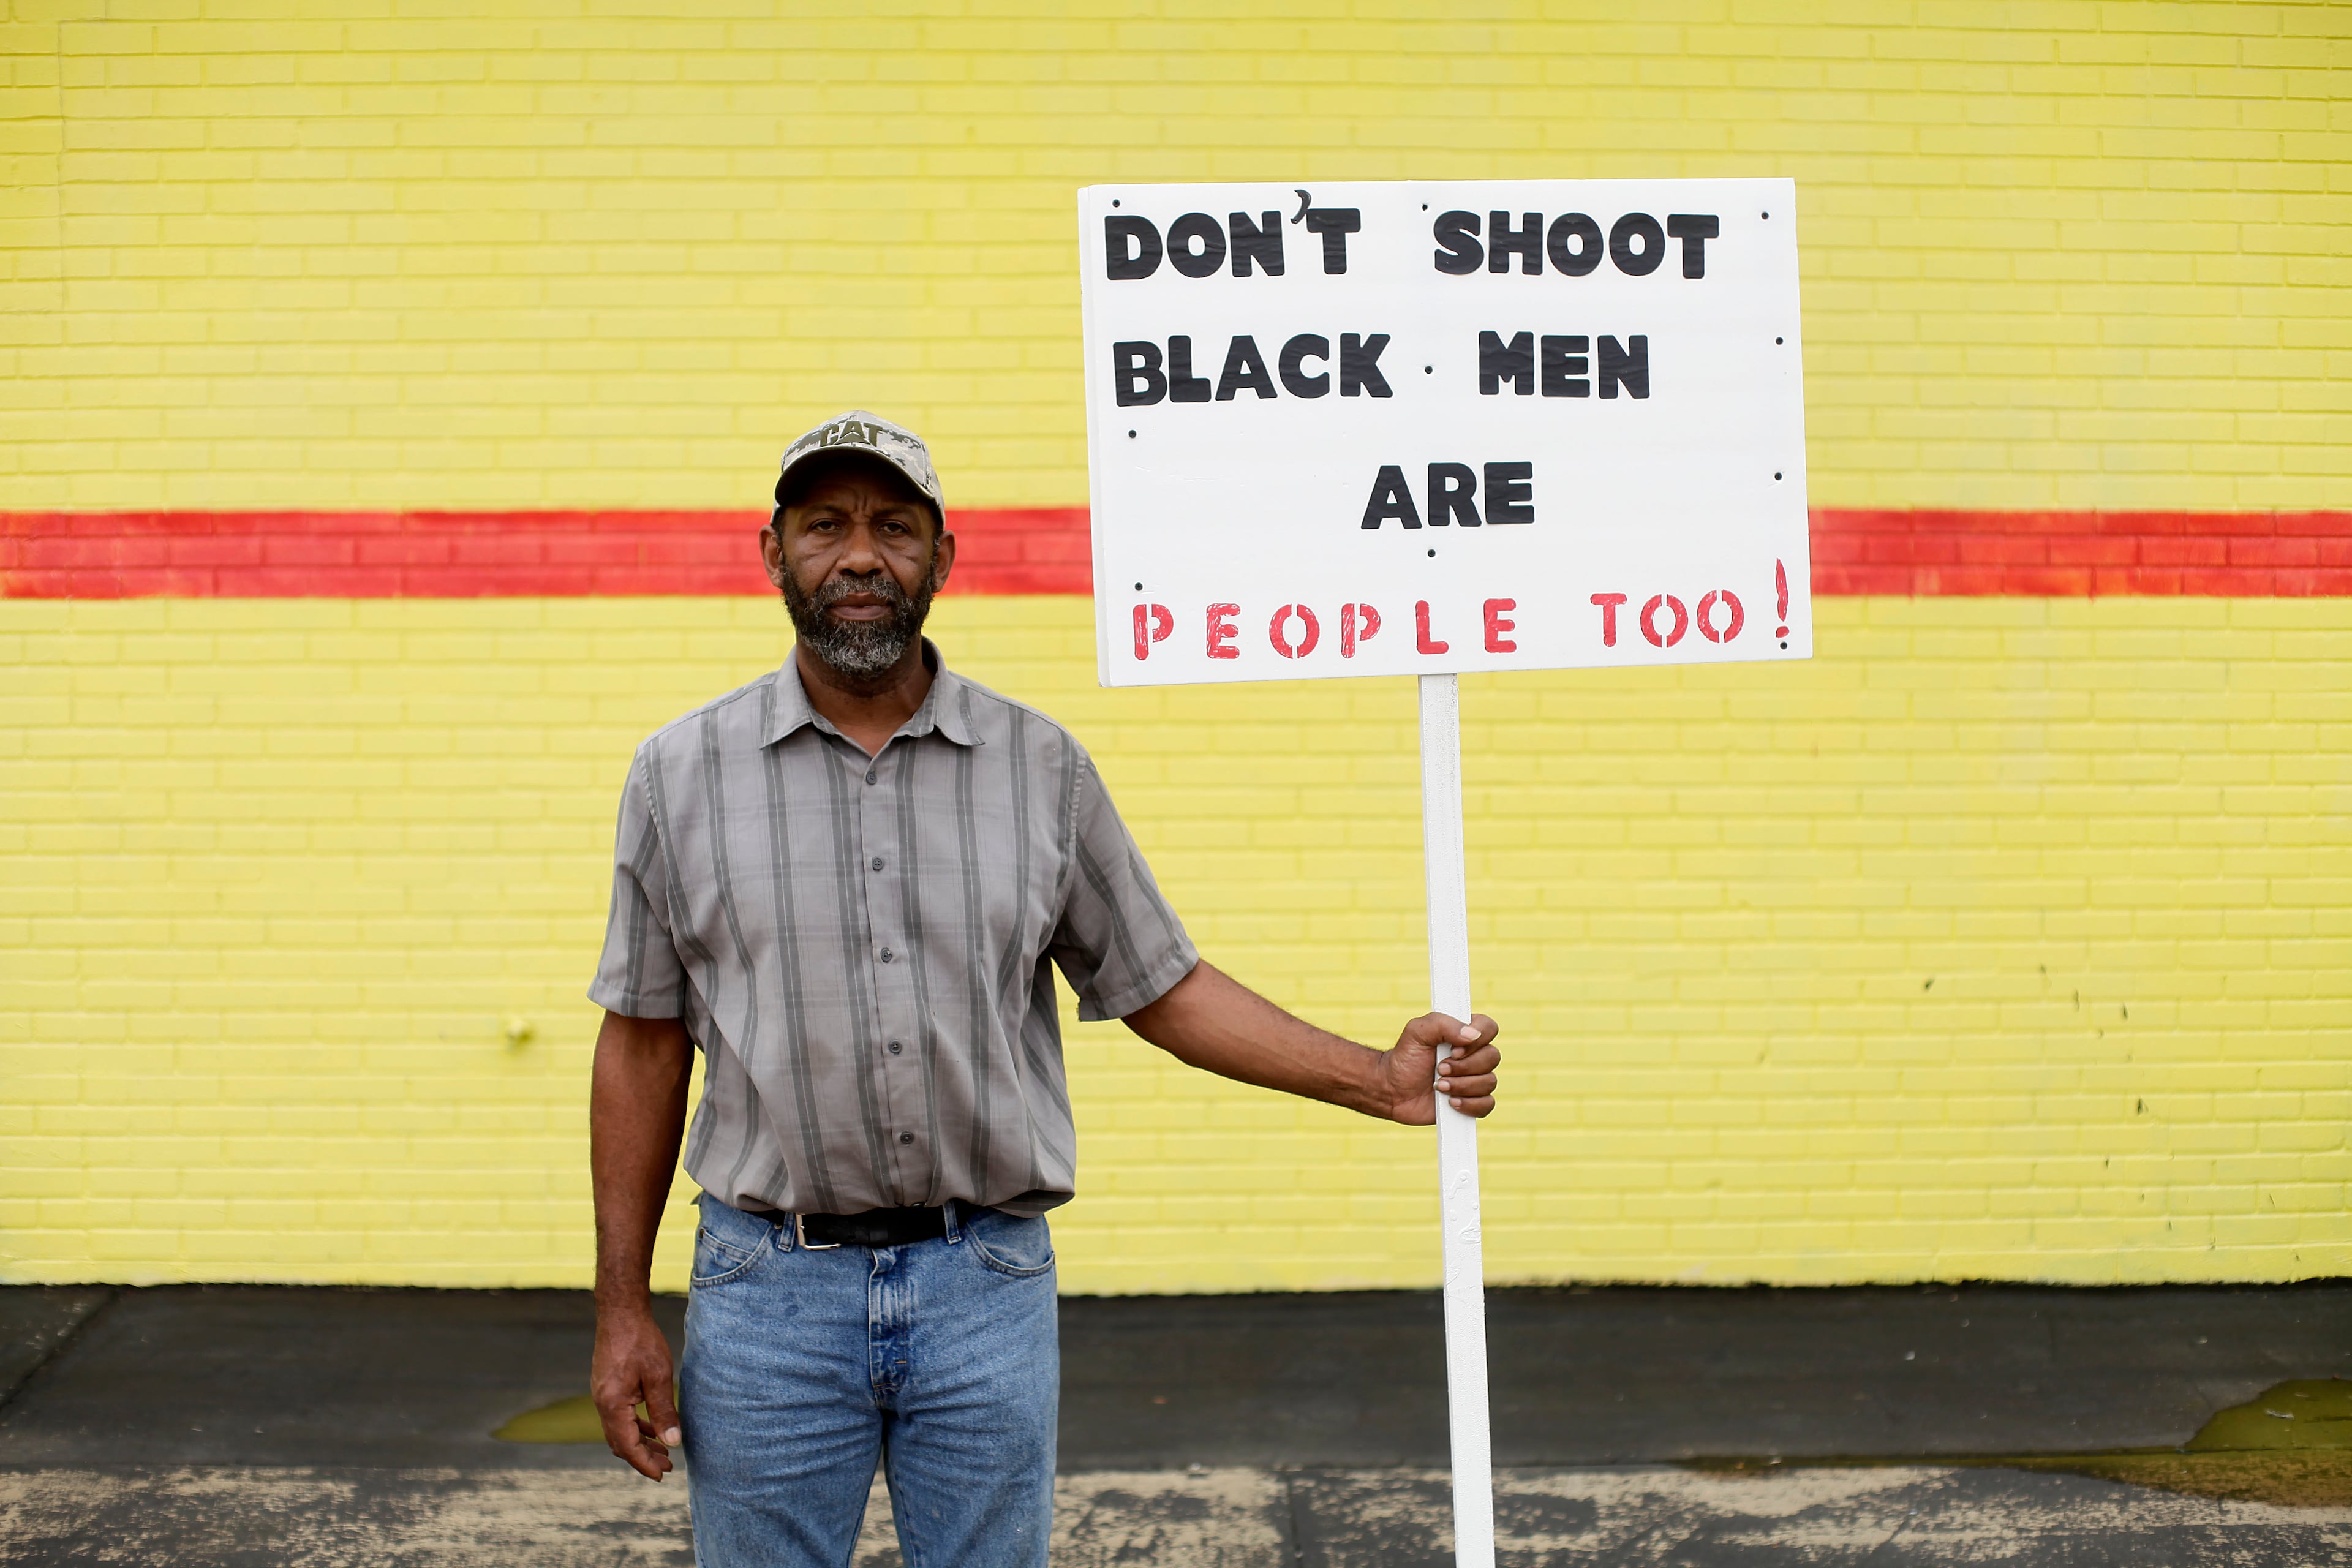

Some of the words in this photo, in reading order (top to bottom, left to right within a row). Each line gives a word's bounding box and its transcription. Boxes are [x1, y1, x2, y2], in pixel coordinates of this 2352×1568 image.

[1104, 189, 1361, 281] DON'T
[1433, 210, 1719, 279] SHOOT
[1112, 333, 1393, 407] BLACK
[1479, 331, 1650, 400] MEN
[819, 420, 883, 447] CAT
[1360, 461, 1535, 530] ARE
[1133, 598, 1517, 661] PEOPLE
[1590, 558, 1790, 648] TOO!
